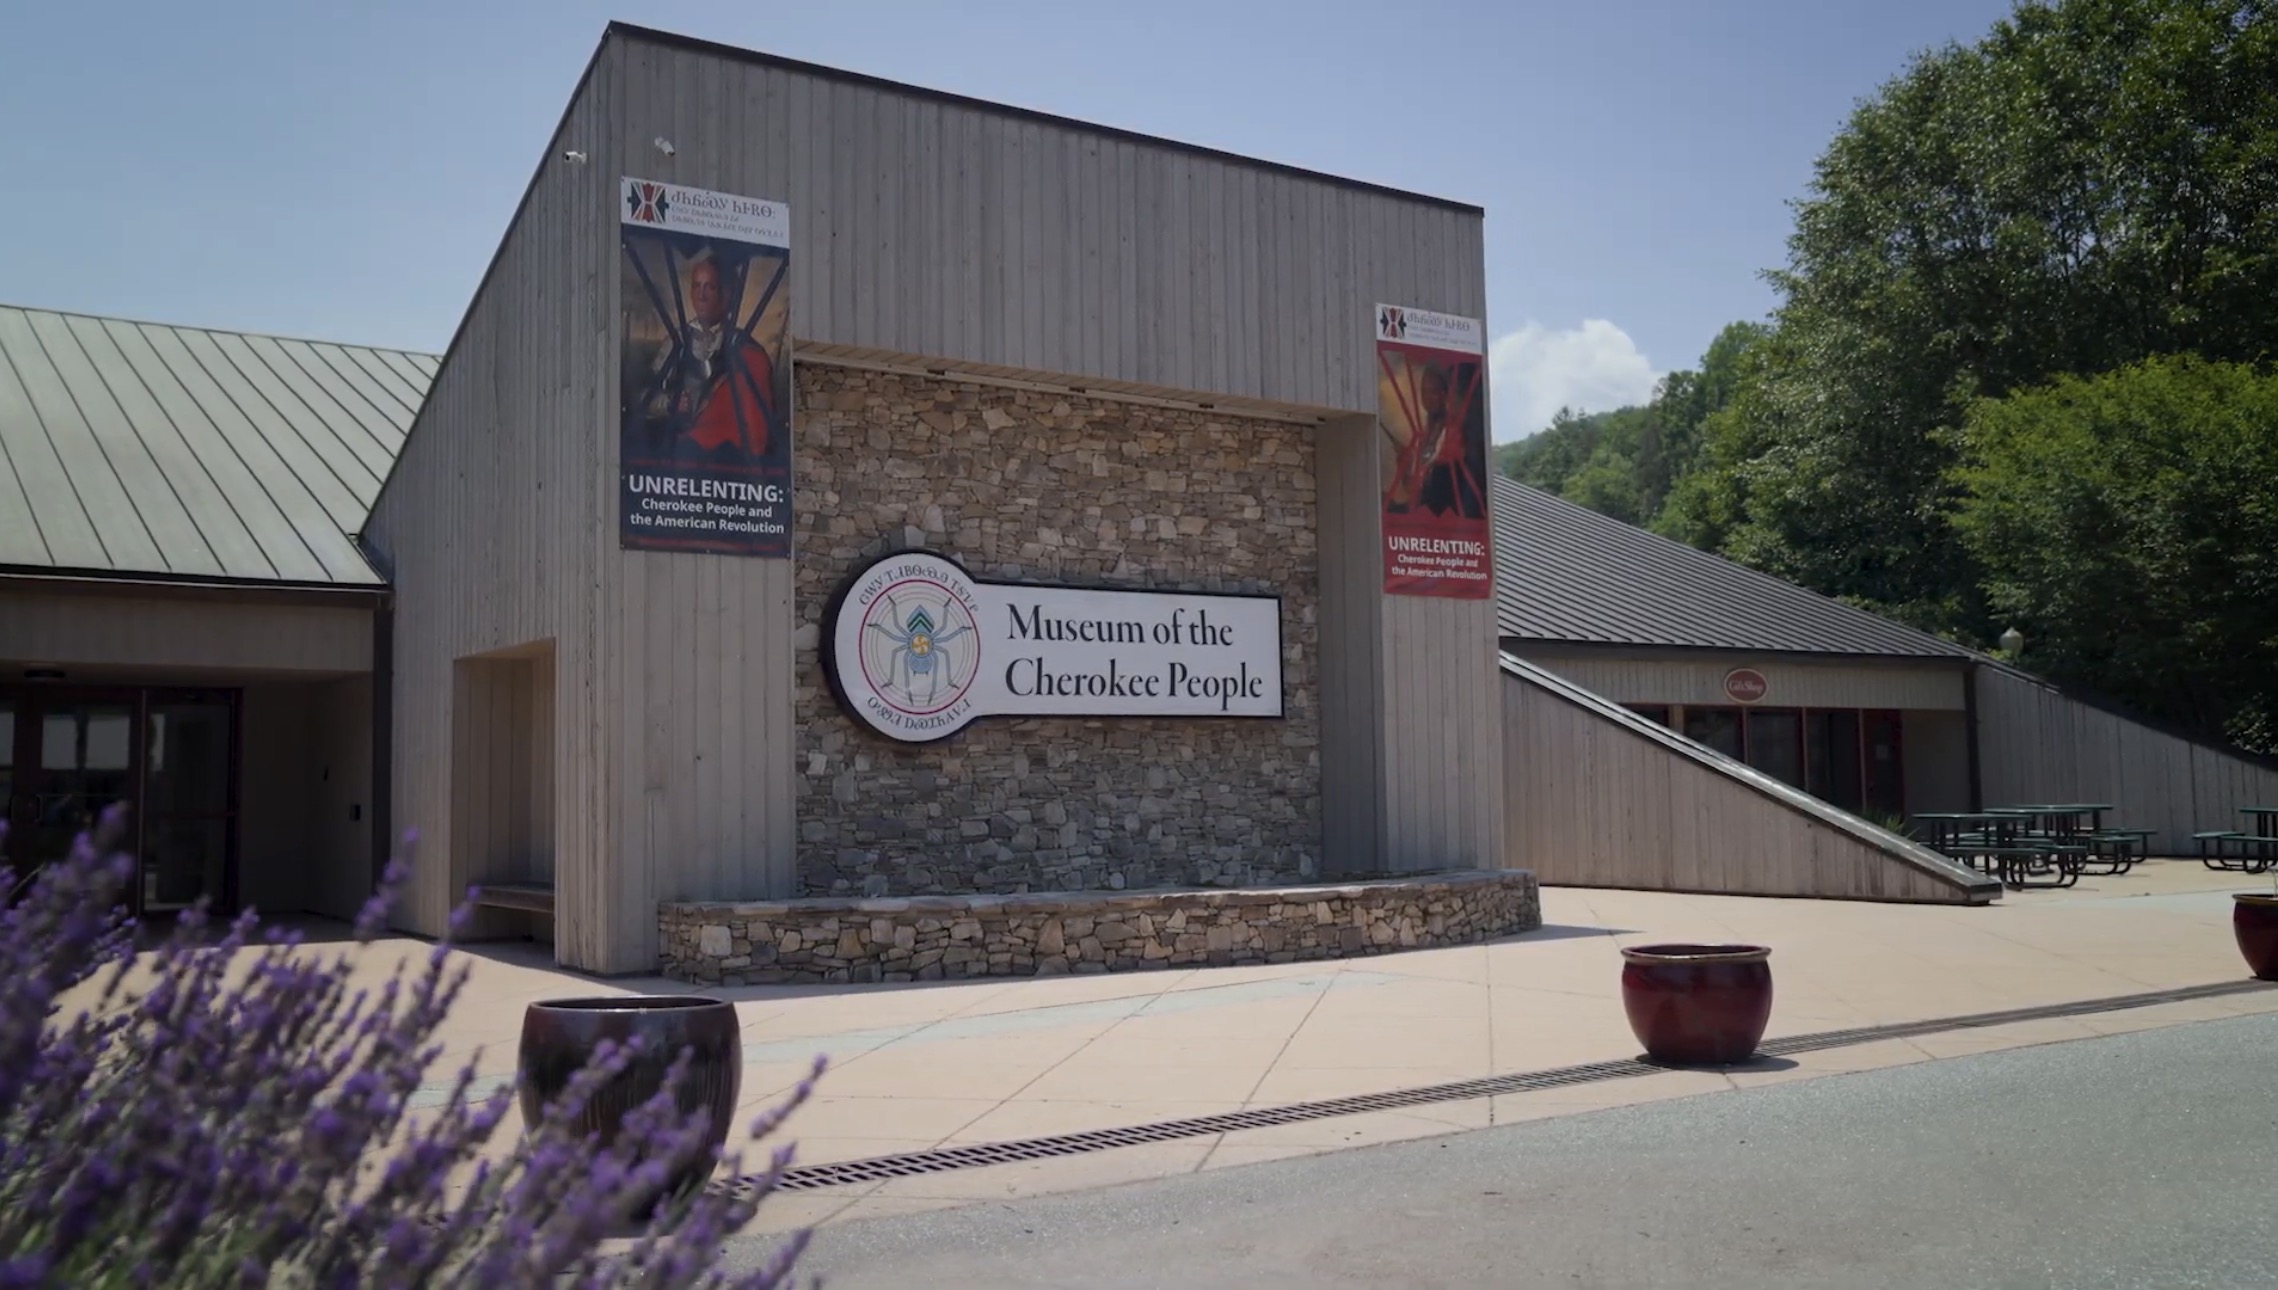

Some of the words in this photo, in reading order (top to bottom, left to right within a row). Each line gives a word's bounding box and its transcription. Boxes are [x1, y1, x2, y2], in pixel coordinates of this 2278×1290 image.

[629, 474, 784, 503] UNRELENTING:
[642, 498, 703, 513] Cherokee
[706, 502, 745, 518] People
[748, 506, 772, 518] and
[630, 513, 652, 526] the
[655, 515, 716, 530] American
[719, 519, 784, 534] Revolution
[1388, 535, 1486, 556] UNRELENTING:
[1397, 554, 1434, 565] Cherokee
[1436, 557, 1464, 568] People
[1465, 559, 1478, 568] and
[1391, 566, 1405, 575] the
[1407, 567, 1444, 578] American
[1446, 569, 1487, 580] Revolution
[1006, 602, 1143, 644] Museum
[1153, 607, 1184, 645] of
[1189, 610, 1233, 646] the
[1004, 657, 1160, 697] Cherokee
[1167, 661, 1263, 711] People
